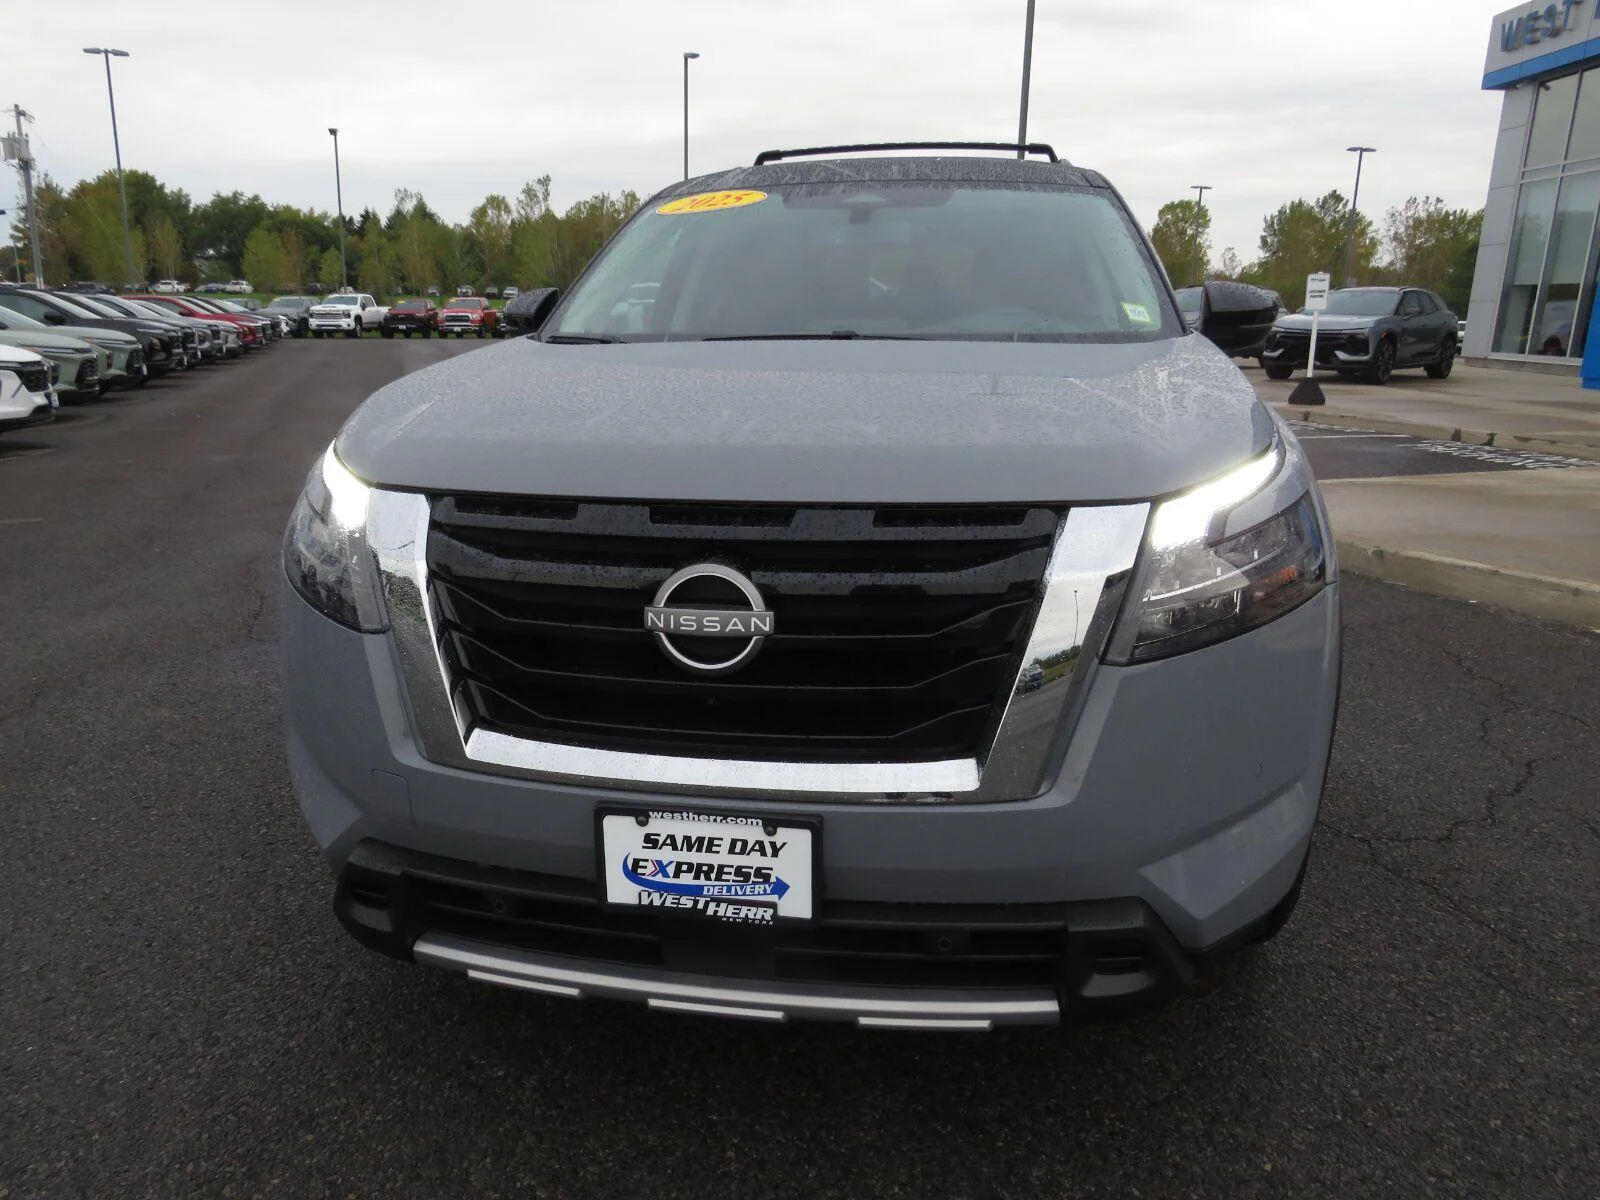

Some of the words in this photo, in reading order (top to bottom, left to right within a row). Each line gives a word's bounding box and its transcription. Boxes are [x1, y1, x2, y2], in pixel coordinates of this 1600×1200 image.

[1501, 0, 1583, 52] WEST
[671, 193, 752, 211] 2025
[647, 611, 770, 632] NISSAN
[649, 811, 762, 826] westherr.com
[642, 832, 723, 854] SAME
[728, 838, 788, 858] DAY
[630, 857, 773, 883] EXPRESS
[703, 884, 774, 896] DELIVERY
